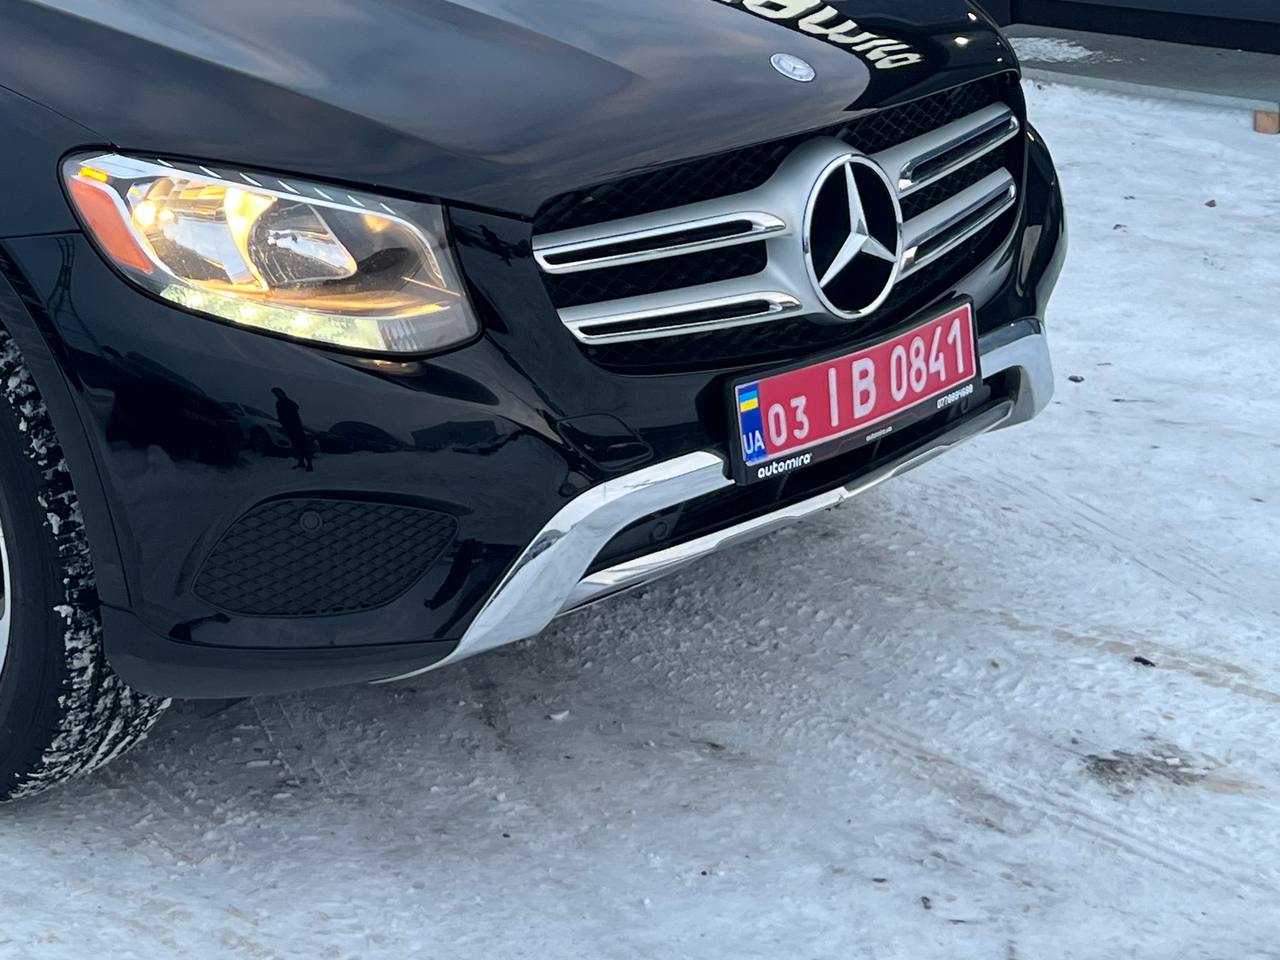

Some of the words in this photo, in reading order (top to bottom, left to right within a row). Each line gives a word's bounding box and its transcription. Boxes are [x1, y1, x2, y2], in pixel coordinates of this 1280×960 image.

[768, 395, 809, 446] 03
[890, 318, 964, 401] 0841
[743, 430, 765, 454] UA
[757, 453, 812, 478] automira
